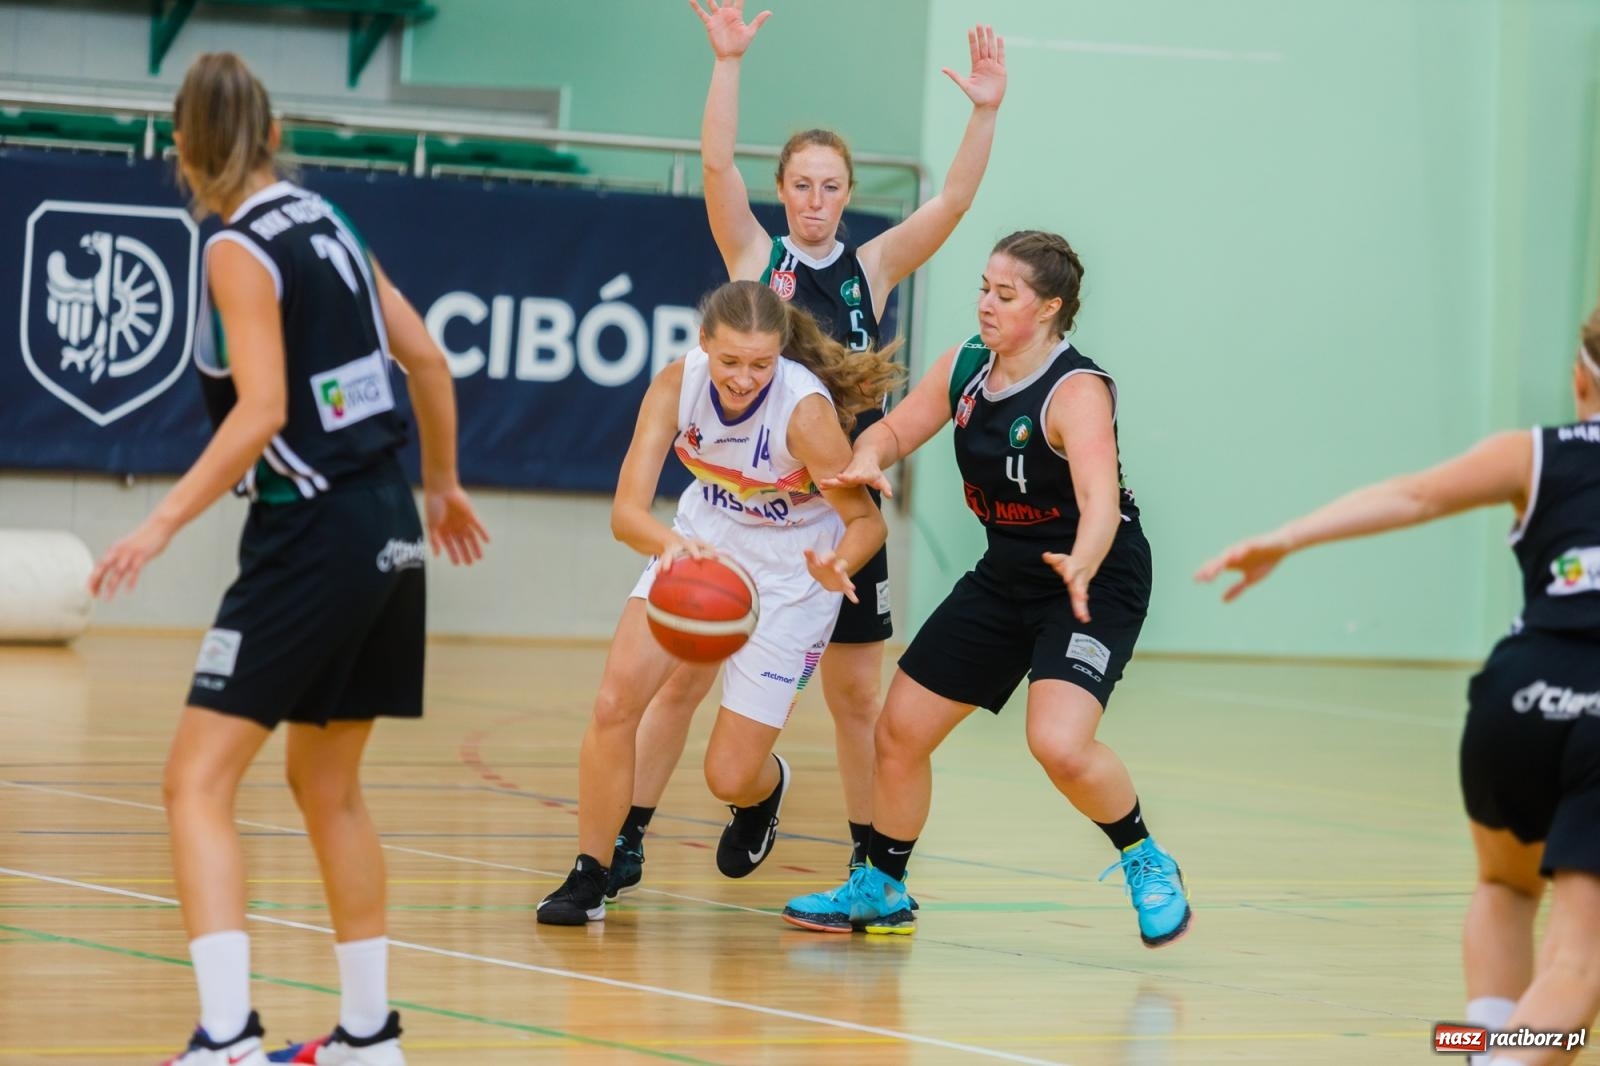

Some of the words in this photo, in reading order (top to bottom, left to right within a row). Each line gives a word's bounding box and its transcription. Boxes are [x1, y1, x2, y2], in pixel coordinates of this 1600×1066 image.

[849, 309, 868, 351] 5
[1005, 454, 1027, 494] 4
[1072, 663, 1102, 682] COLO
